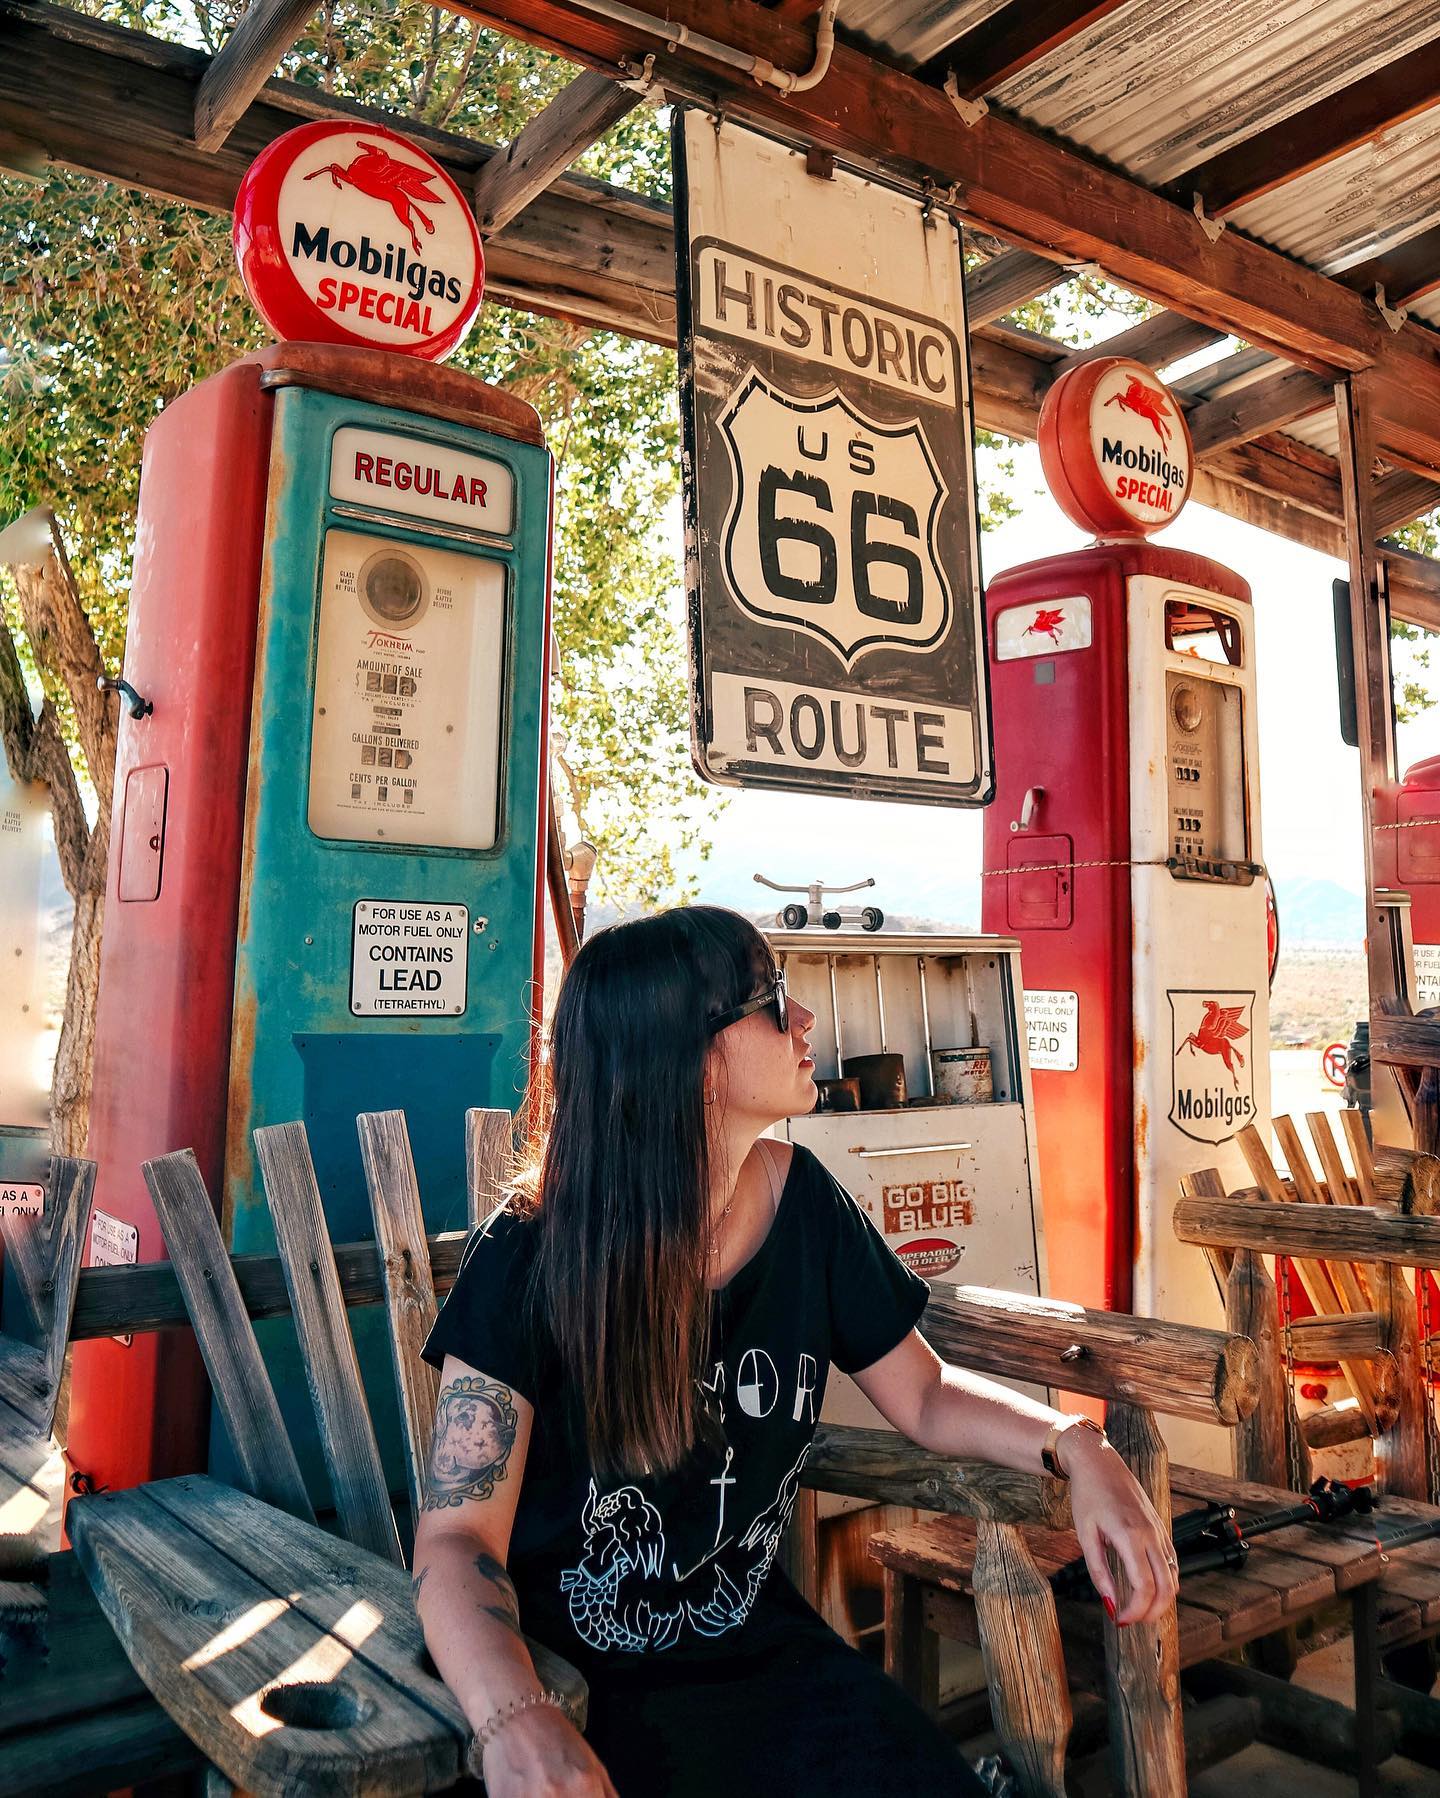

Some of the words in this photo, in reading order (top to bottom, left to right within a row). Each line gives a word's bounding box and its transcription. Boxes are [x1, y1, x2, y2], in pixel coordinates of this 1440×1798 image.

[292, 222, 462, 304] Mobilgas
[316, 277, 434, 337] SPECIAL
[713, 258, 948, 395] HISTORIC
[1101, 437, 1184, 489] Mobilgas
[354, 451, 488, 508] REGULAR
[1115, 476, 1173, 513] SPECIAL
[758, 465, 924, 625] 66
[357, 659, 391, 673] AMOUNT
[392, 664, 402, 675] OF
[404, 666, 423, 678] SALE
[352, 732, 383, 746] GALLONS
[386, 736, 420, 750] DELIVERED
[744, 685, 951, 775] ROUTE
[350, 772, 372, 784] CENTS
[376, 775, 388, 786] PER
[392, 778, 418, 788] GALLON
[372, 908, 396, 919] FOR
[400, 910, 422, 920] USE
[426, 910, 440, 921] AS
[444, 912, 452, 922] A
[358, 924, 400, 936] MOTOR
[404, 926, 432, 937] FUEL
[436, 927, 464, 938] ONLY
[370, 946, 454, 962] CONTAINS
[380, 969, 442, 992] LEAD
[374, 998, 446, 1010] (TETRAETHYL)
[1048, 996, 1058, 1004] AS
[1028, 1036, 1060, 1052] EAD
[1178, 1088, 1250, 1126] Mobilgas
[20, 1191, 28, 1202] A
[888, 1186, 924, 1208] GO
[899, 1206, 965, 1231] BLUE
